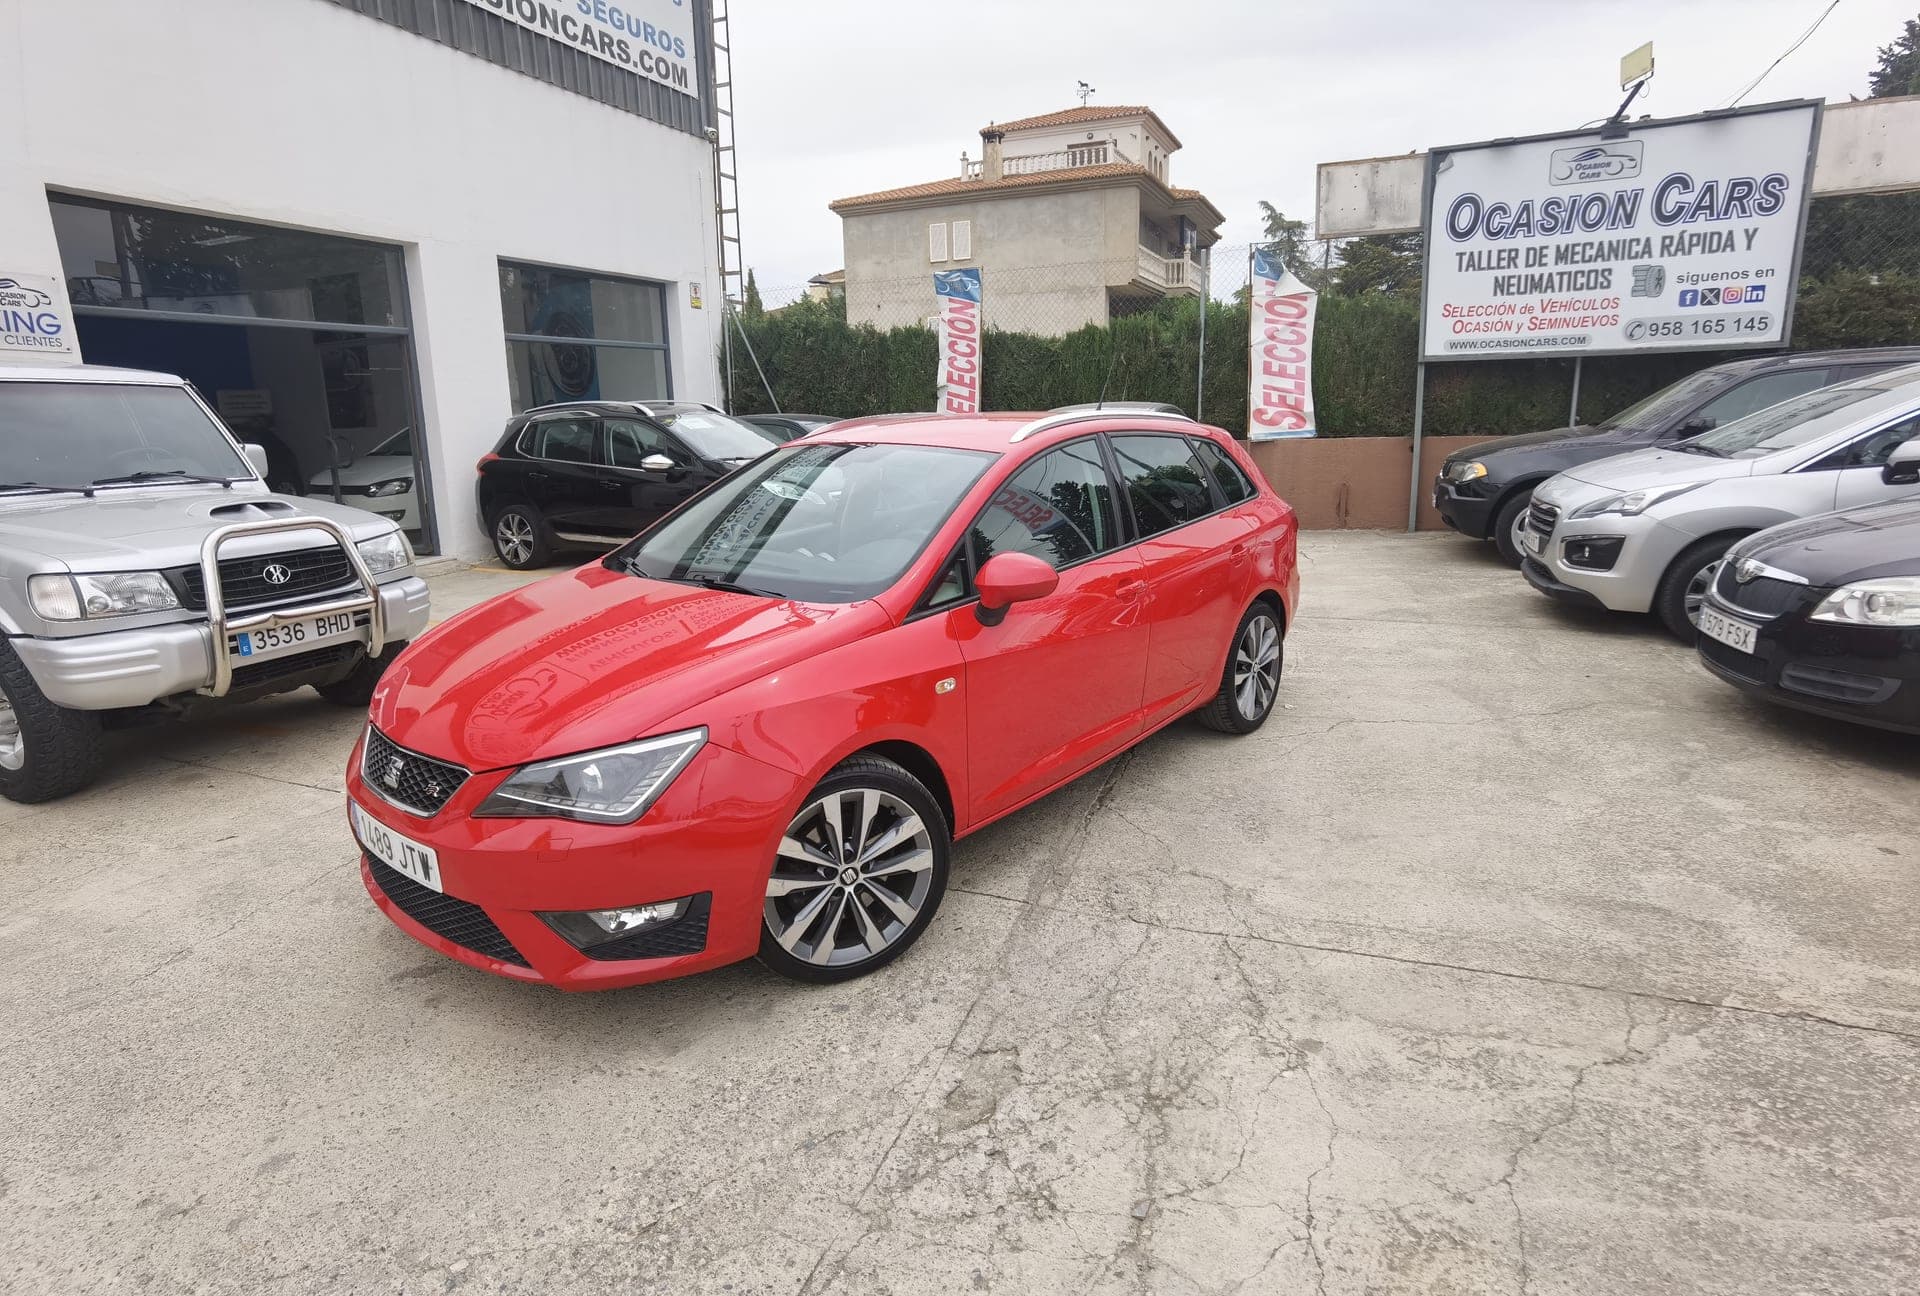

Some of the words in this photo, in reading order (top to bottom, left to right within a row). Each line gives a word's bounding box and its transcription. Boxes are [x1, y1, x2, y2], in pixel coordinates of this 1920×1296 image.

[577, 0, 686, 59] SEGUROS
[1446, 188, 1644, 242] OCASION
[1651, 172, 1789, 227] CARS
[1456, 248, 1519, 272] TALLER
[1525, 245, 1549, 268] DE
[1555, 236, 1653, 266] MECANICA
[1660, 229, 1735, 258] RÁPIDA
[1744, 227, 1759, 251] Y
[1493, 268, 1612, 296] NEUMATICOS
[1755, 267, 1775, 278] en
[1442, 301, 1517, 318] SELECCIÓN
[1519, 303, 1535, 315] de
[1540, 296, 1620, 314] VEHÍCULOS
[0, 309, 61, 335] ING
[1452, 318, 1514, 335] OCASIÓN
[1515, 321, 1524, 335] y
[1528, 314, 1620, 332] SEMINUEVOS
[1649, 321, 1683, 337] 958
[1691, 318, 1726, 335] 165
[1734, 316, 1769, 332] 145
[4, 334, 63, 347] CLIENTES
[1449, 336, 1587, 350] WWW.OCASIONCARS.COM
[254, 623, 305, 650] 3536
[315, 612, 350, 637] BHD
[1727, 622, 1751, 649] FSX
[361, 815, 393, 861] 1489
[399, 841, 432, 883] JTW
